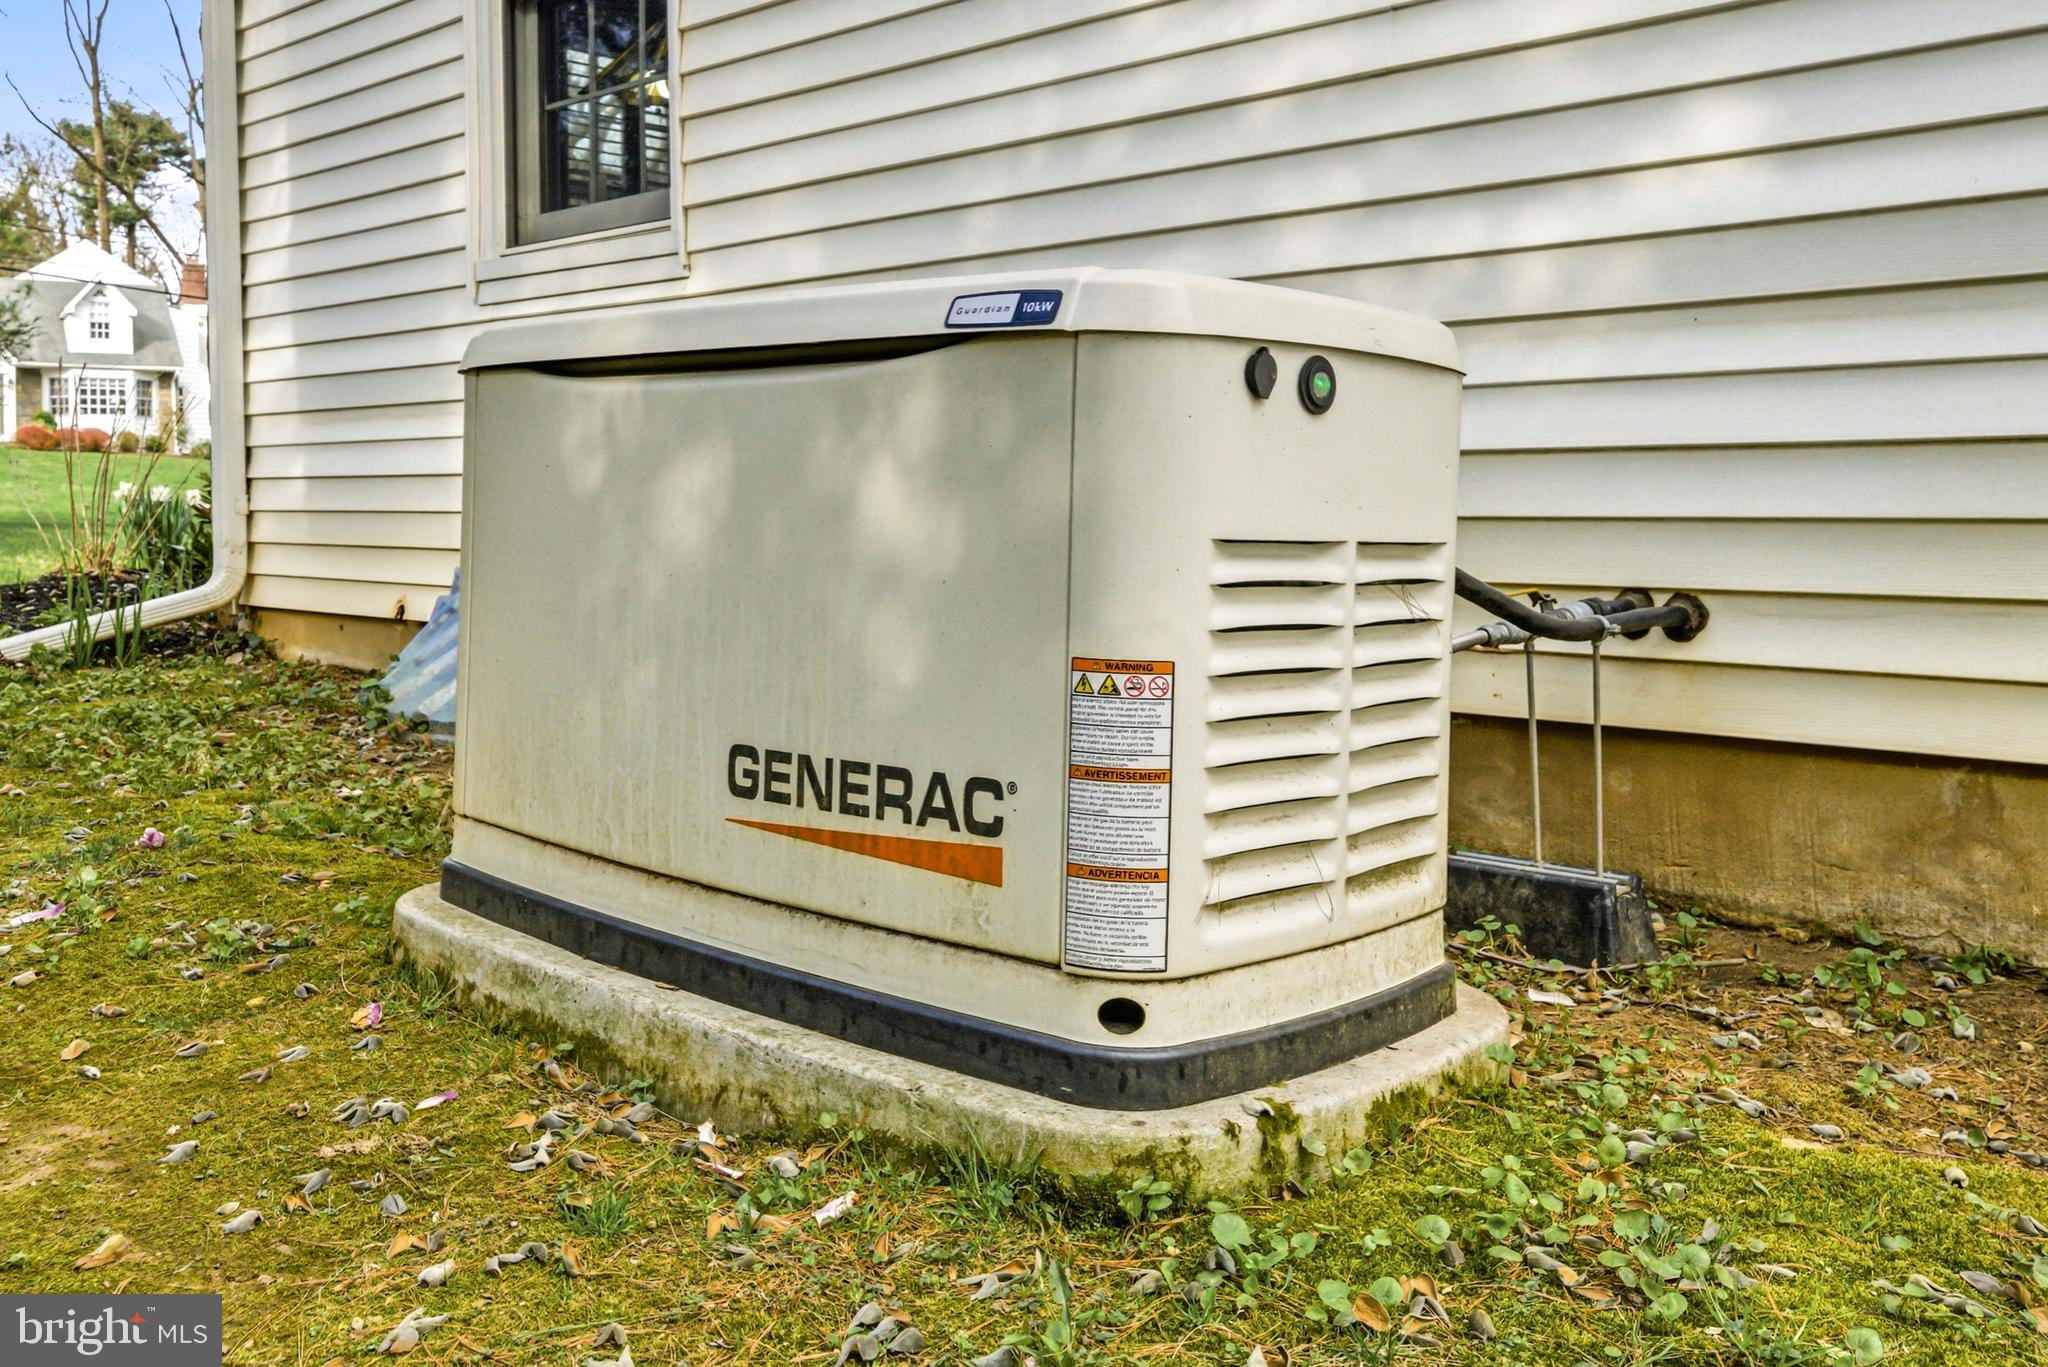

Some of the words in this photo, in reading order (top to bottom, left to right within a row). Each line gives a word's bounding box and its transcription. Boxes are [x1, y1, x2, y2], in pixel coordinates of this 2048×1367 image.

[956, 305, 1011, 315] Guardian
[1022, 301, 1055, 313] 10kW
[1104, 662, 1154, 672] WARNING
[1084, 768, 1167, 781] AVERTISSEMENT
[1088, 868, 1160, 880] ADVERTENCIA
